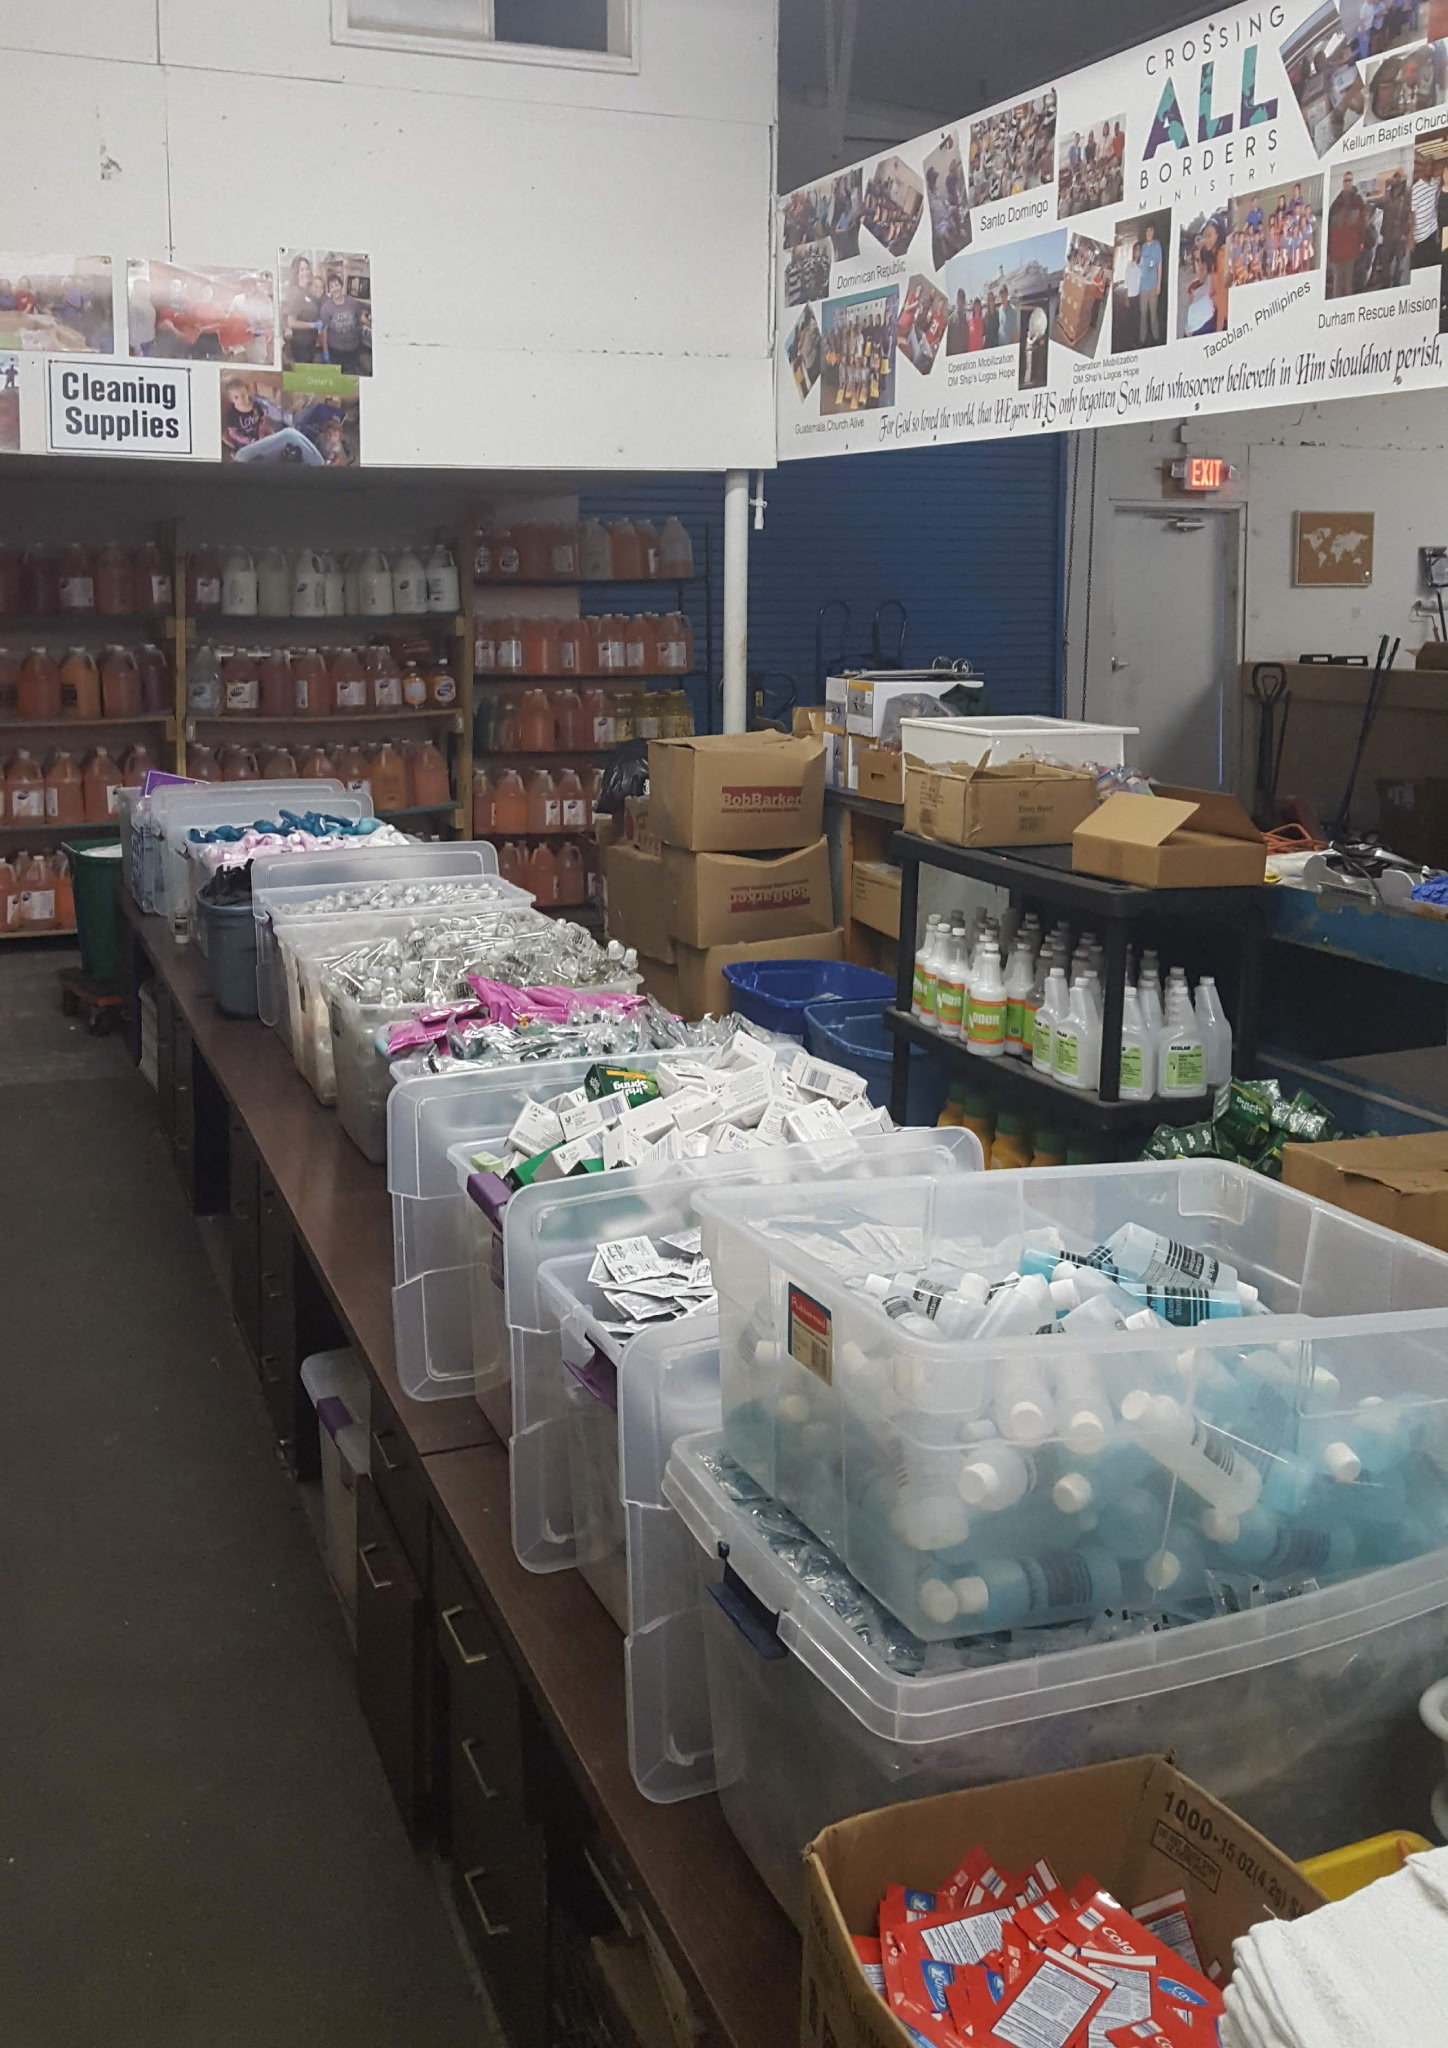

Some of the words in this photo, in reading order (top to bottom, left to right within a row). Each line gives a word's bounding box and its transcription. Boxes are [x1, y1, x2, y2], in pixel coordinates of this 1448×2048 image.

[1147, 5, 1284, 75] CROSSING
[1142, 44, 1279, 162] ALL
[1342, 132, 1375, 153] Kellum
[1378, 122, 1412, 142] Baptist
[1415, 111, 1448, 131] Churc
[1140, 129, 1277, 190] BORDERS
[1139, 162, 1276, 212] MINISTRY
[980, 215, 1006, 232] Santo
[1008, 200, 1049, 224] Domingo
[837, 266, 876, 289] Dominican
[876, 260, 906, 280] Republic
[1203, 323, 1254, 360] Tacoblan,
[1254, 281, 1312, 327] Phillipines
[1318, 308, 1356, 330] Durham
[1358, 304, 1396, 322] Rescue
[1398, 296, 1439, 317] Mission
[948, 361, 976, 373] Operation
[998, 368, 1016, 380] Hope
[1073, 361, 1101, 372] Operation
[1123, 367, 1140, 378] Hope
[62, 372, 176, 409] Cleaning
[879, 414, 894, 442] For
[895, 410, 912, 439] God
[912, 416, 919, 432] so
[920, 408, 940, 431] loved
[940, 406, 951, 429] the
[952, 402, 976, 427] world,
[977, 401, 992, 424] that
[1059, 388, 1078, 424] only
[1079, 387, 1116, 422] begotten
[1145, 376, 1165, 404] that
[1167, 373, 1225, 399] whosoever
[1226, 363, 1276, 393] believeth
[1280, 360, 1291, 384] in
[1296, 352, 1326, 386] Him
[1395, 332, 1443, 385] perish,
[65, 406, 179, 441] Supplies
[827, 418, 849, 431] Church
[850, 417, 865, 428] Alive
[1192, 458, 1222, 487] EXIT
